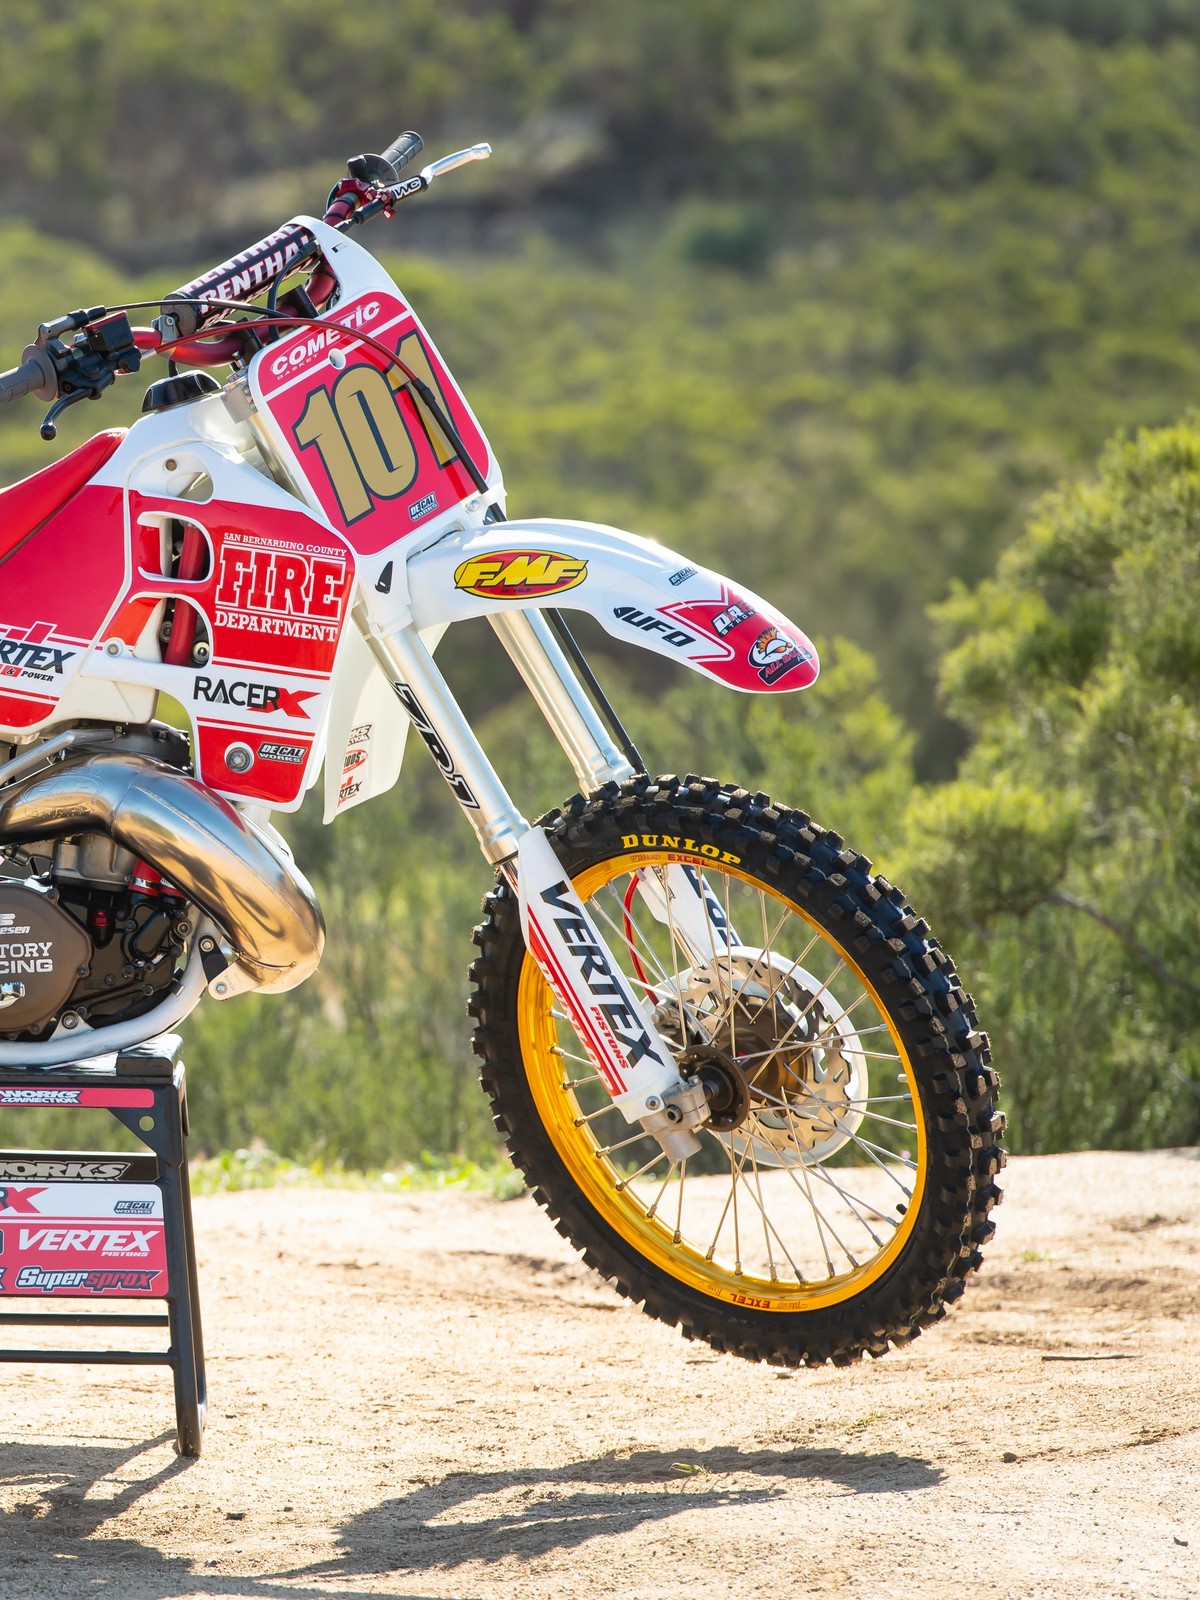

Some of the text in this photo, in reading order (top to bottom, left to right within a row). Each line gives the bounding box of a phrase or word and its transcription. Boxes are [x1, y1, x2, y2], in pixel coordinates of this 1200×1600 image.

[277, 352, 319, 380] GASKET
[291, 328, 464, 528] 101
[223, 532, 347, 557] SAN BERNARDINO COUNTY
[215, 543, 347, 621] FIRE
[454, 554, 589, 589] FMF
[214, 610, 338, 642] DEPARTMENT
[622, 611, 696, 647] UFO
[20, 671, 54, 682] POWER
[259, 752, 301, 763] WORKS
[260, 744, 304, 757] DECAL
[339, 781, 363, 799] RTEX
[621, 834, 742, 865] DUNLOP
[667, 853, 709, 866] EXCEL
[540, 880, 666, 1069] VERTEX
[590, 1006, 629, 1070] PISTONS
[117, 1201, 152, 1209] DECAL
[18, 1229, 160, 1252] VERTEX
[18, 1267, 152, 1292] Supersprox
[730, 1292, 771, 1309] EXCEL
